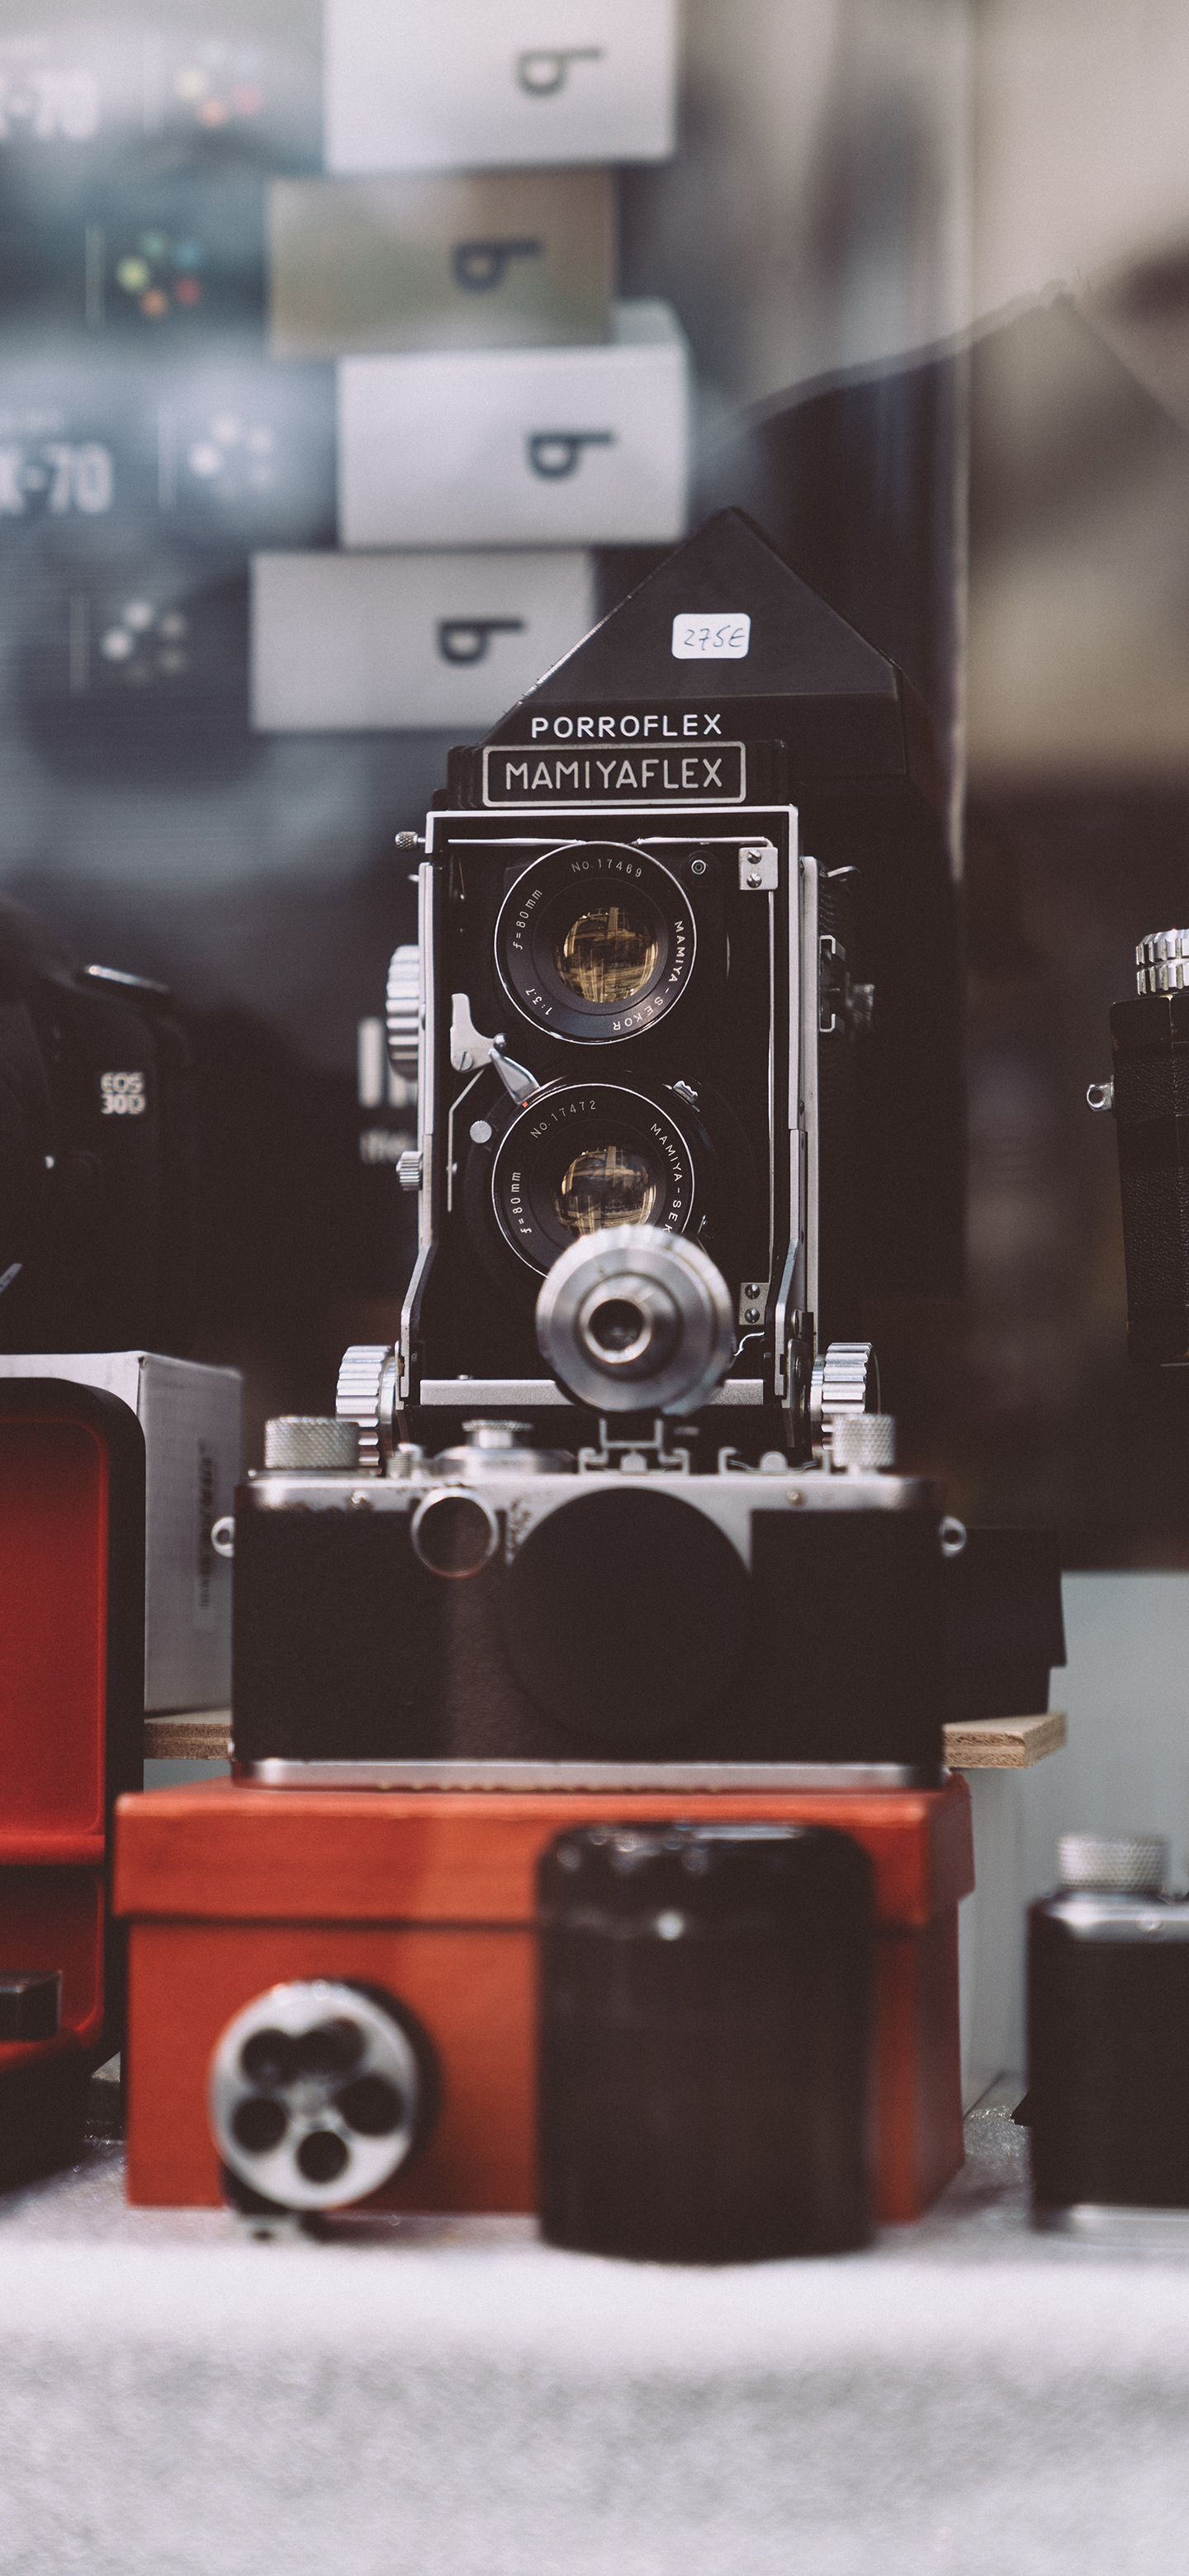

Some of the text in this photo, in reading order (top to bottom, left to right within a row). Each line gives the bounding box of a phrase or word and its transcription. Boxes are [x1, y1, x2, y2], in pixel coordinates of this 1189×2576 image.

[531, 713, 722, 738] PORROFLEX
[505, 758, 722, 790] MAMIYAFLEX
[101, 1073, 143, 1093] EOS
[101, 1094, 145, 1115] 30D
